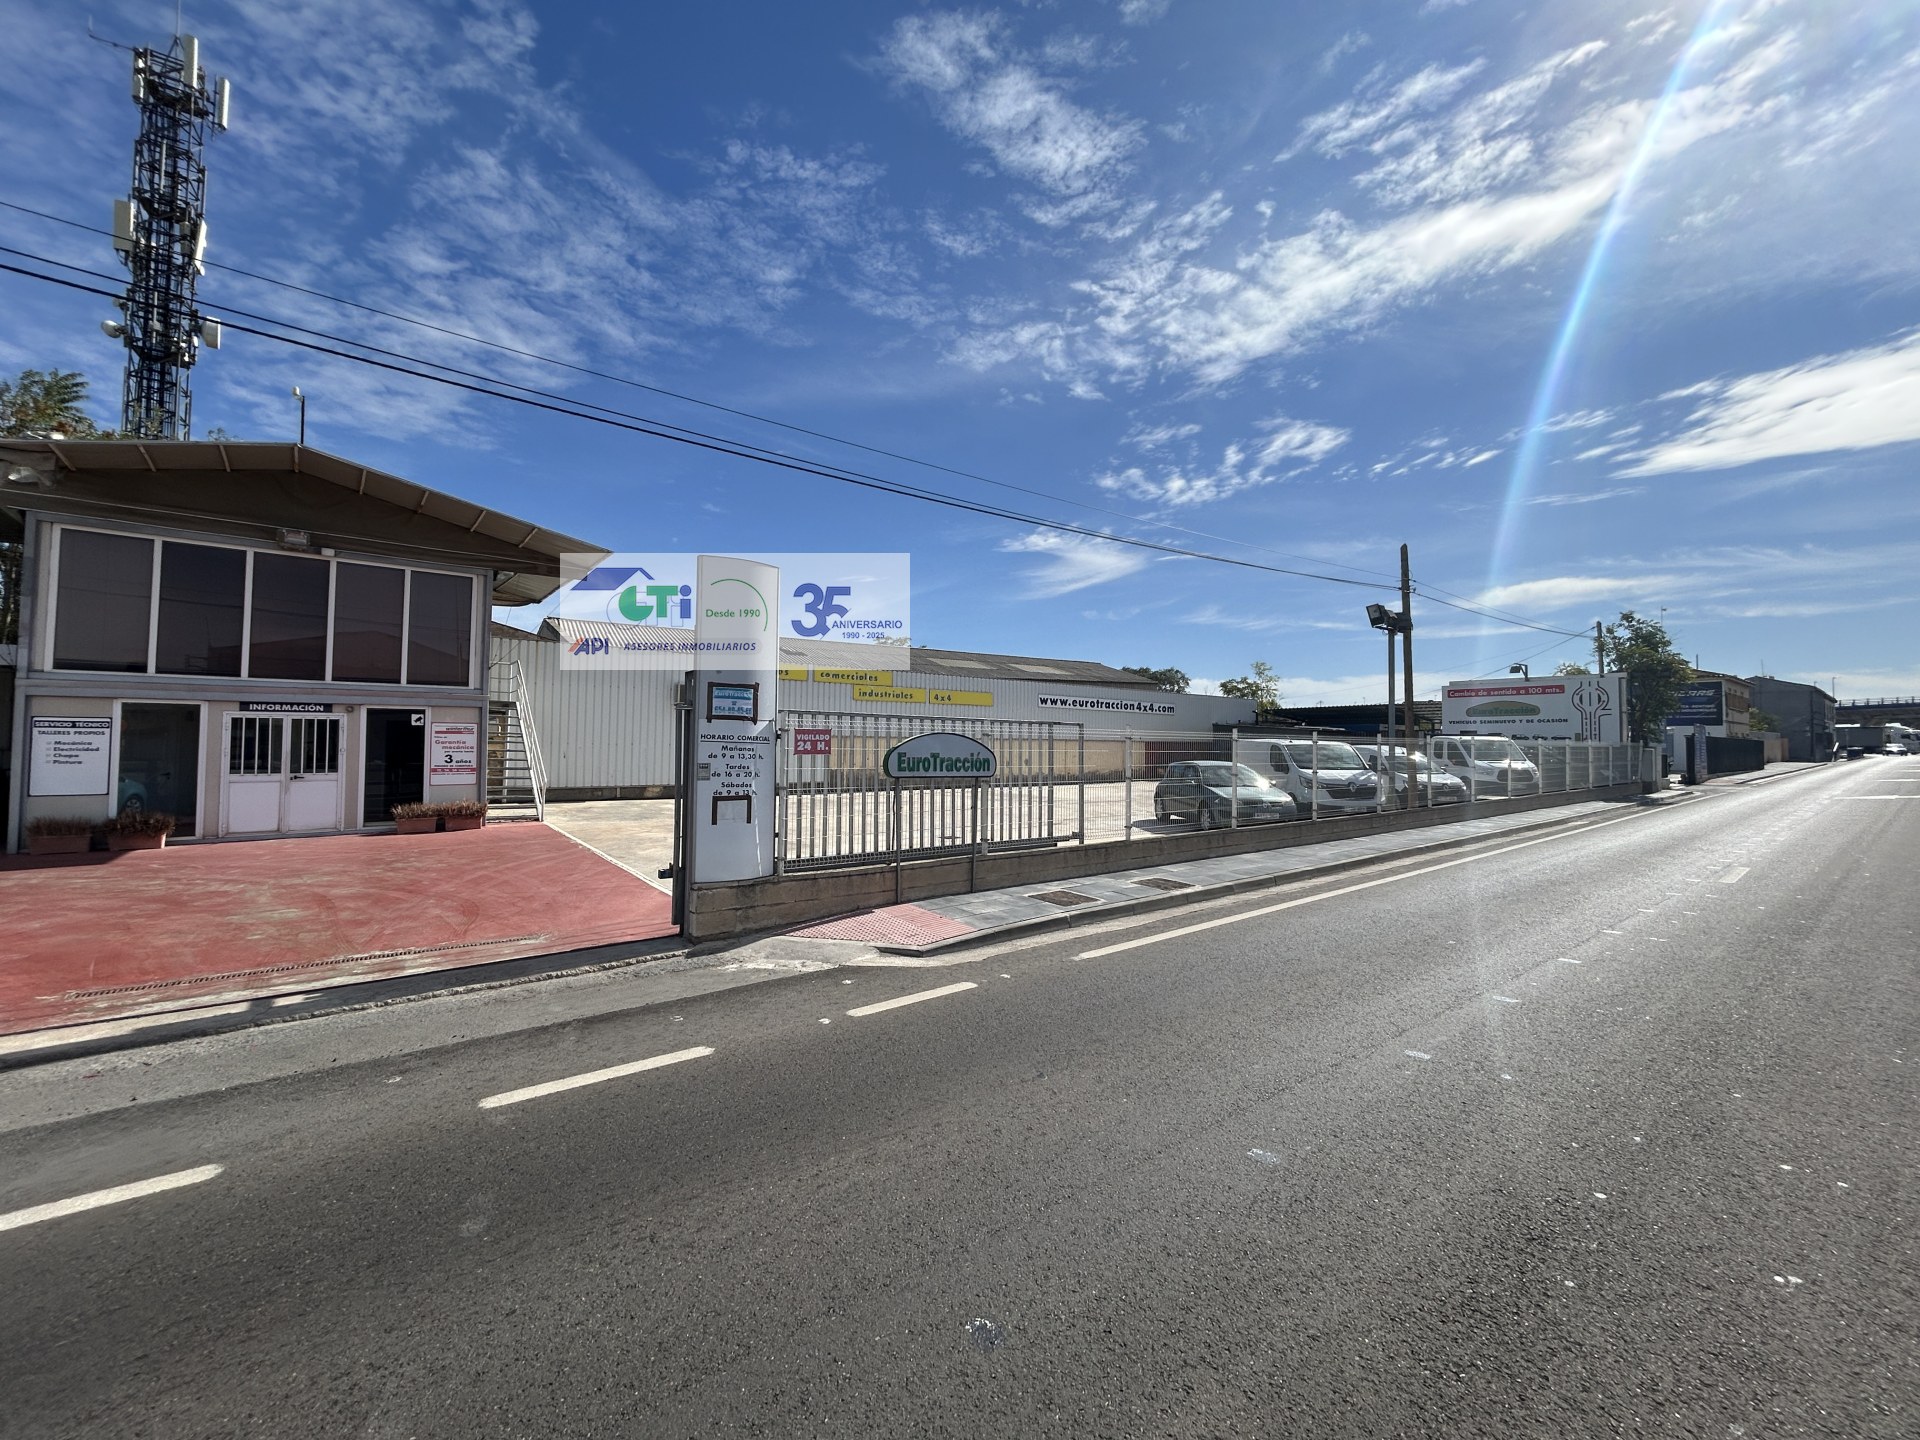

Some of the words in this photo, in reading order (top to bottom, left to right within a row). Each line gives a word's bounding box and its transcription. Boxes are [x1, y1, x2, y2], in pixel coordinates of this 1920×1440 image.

[820, 672, 878, 682] comerciales
[858, 688, 914, 699] industriales
[1490, 687, 1517, 695] sentido
[249, 703, 324, 711] INFORMACIÓN
[1039, 696, 1175, 713] www.eurotraccion4x4.com
[737, 734, 770, 742] COMERCIAL
[796, 741, 812, 751] 24
[816, 741, 829, 751] H.
[444, 754, 453, 764] 3
[897, 751, 990, 772] EuroTracción
[724, 770, 733, 778] 16
